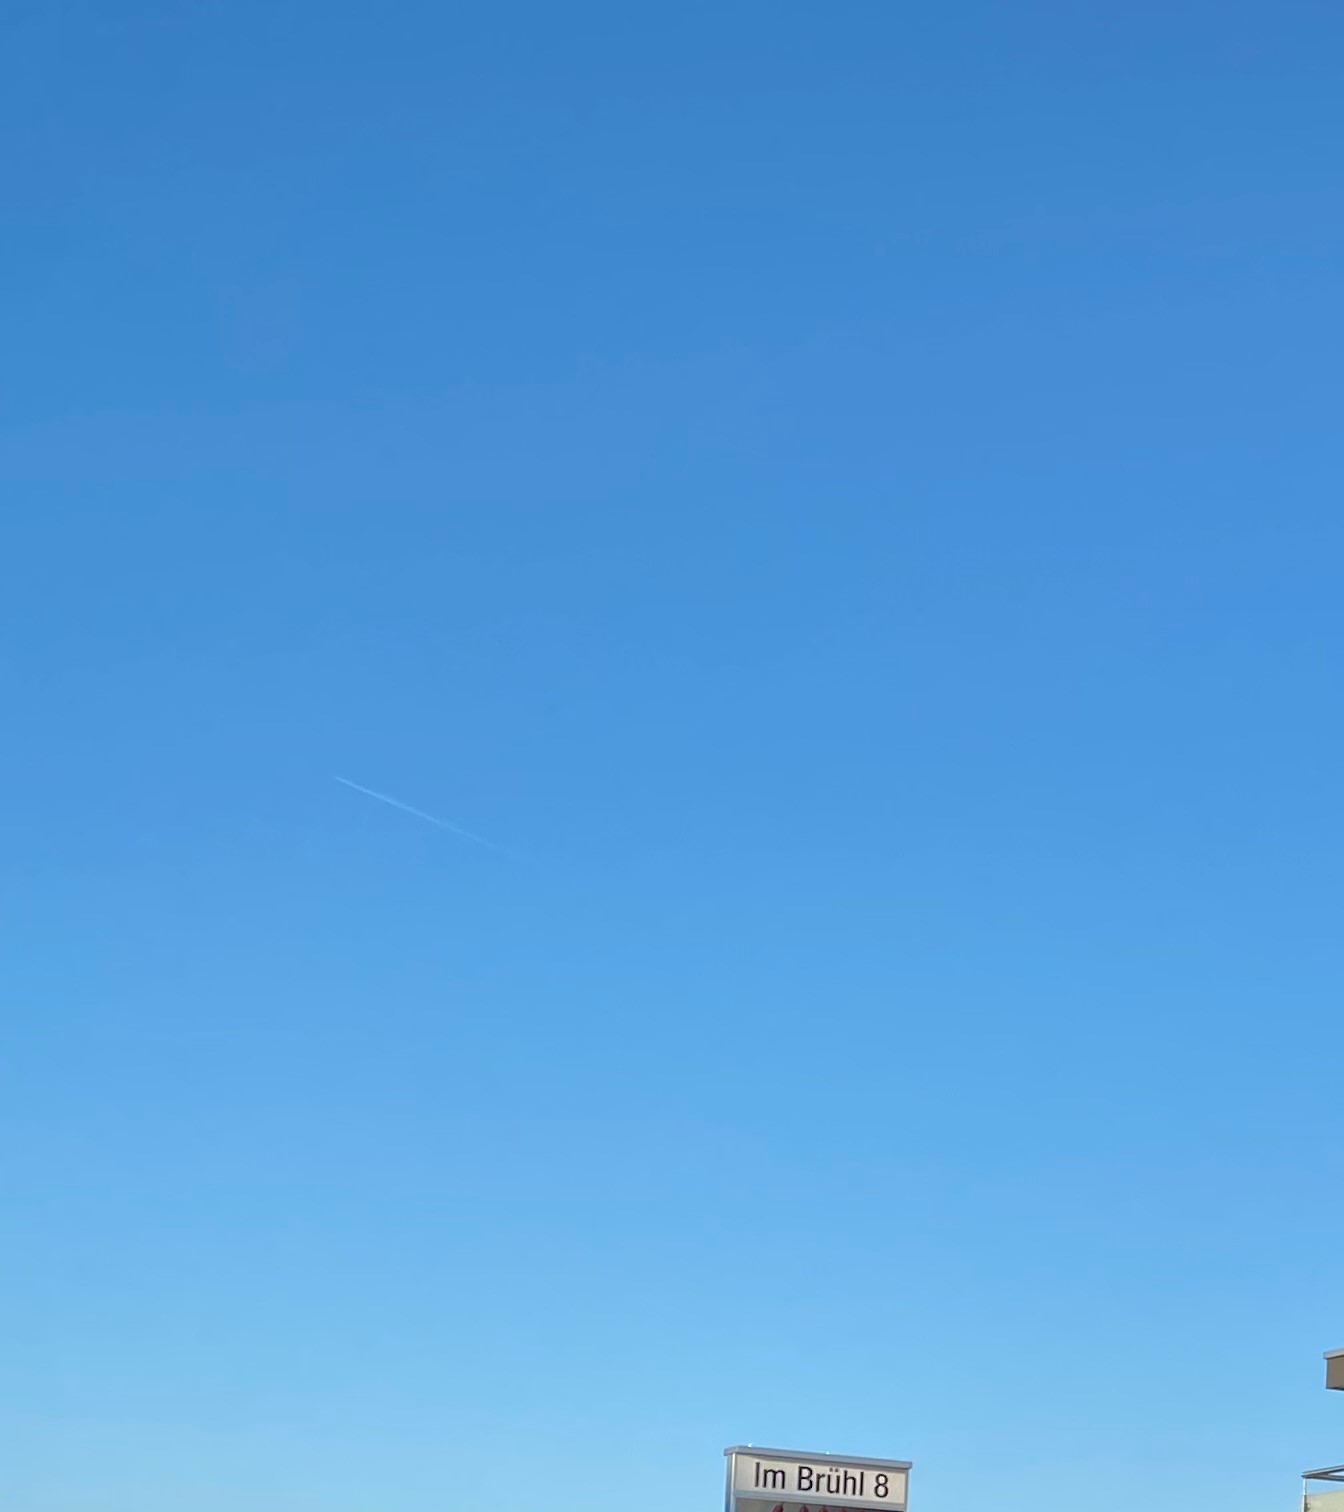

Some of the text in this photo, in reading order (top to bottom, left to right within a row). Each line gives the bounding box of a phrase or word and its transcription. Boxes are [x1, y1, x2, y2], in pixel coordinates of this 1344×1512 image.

[754, 1462, 889, 1498] Im Brühl 8
